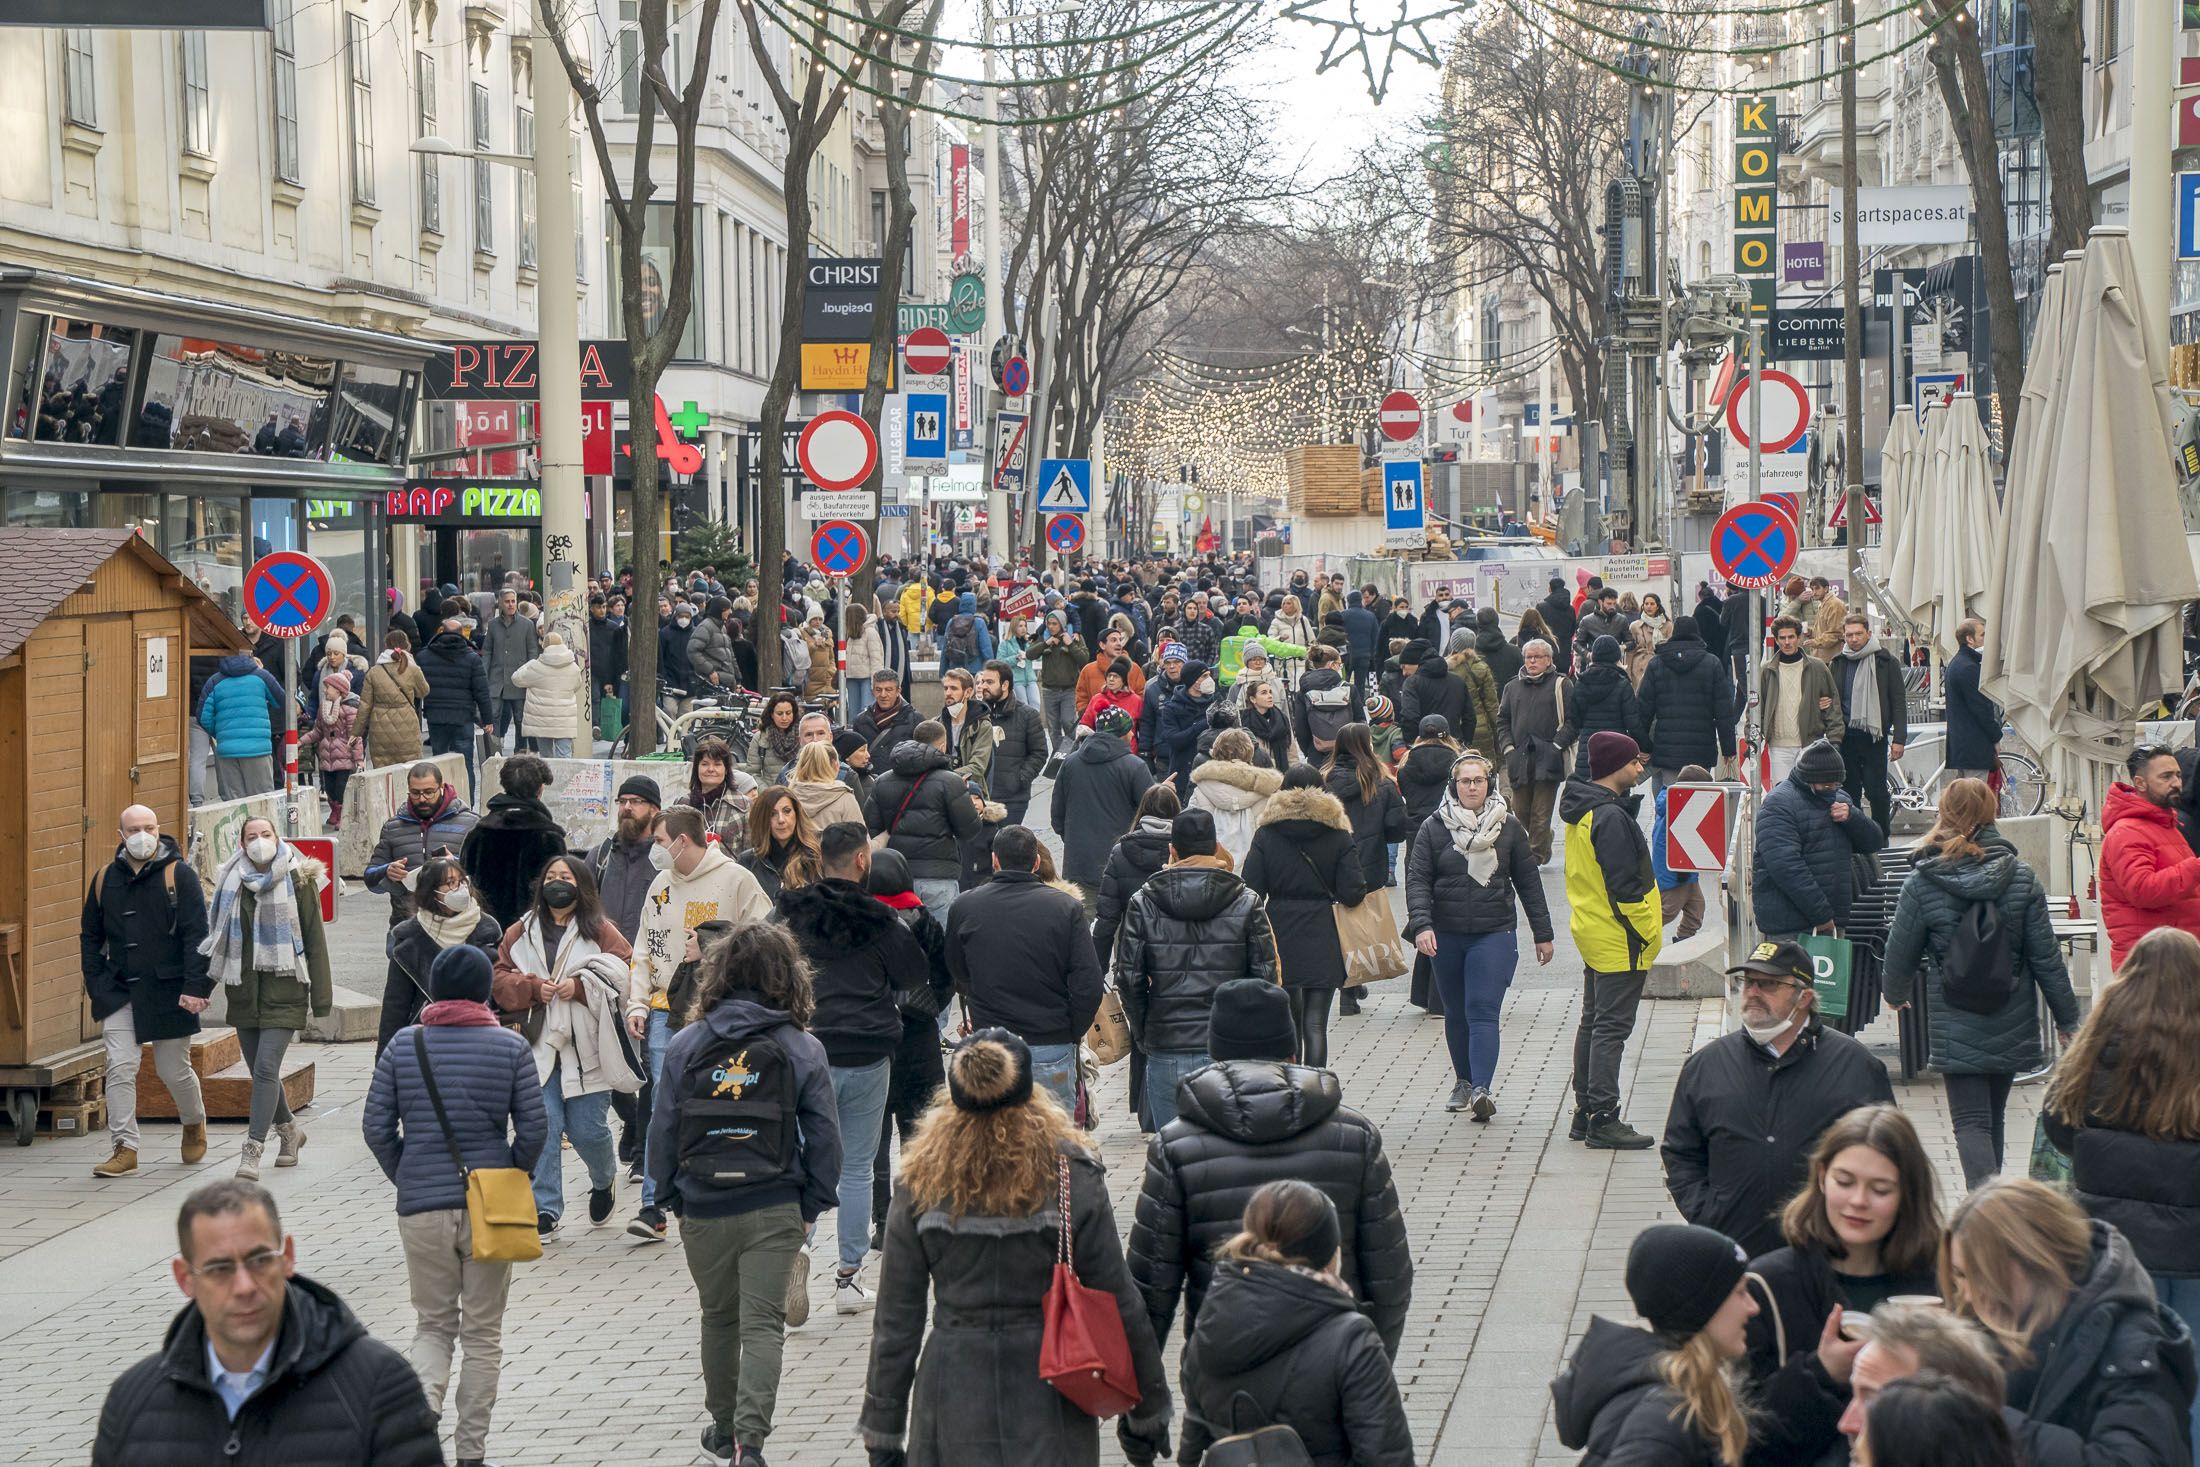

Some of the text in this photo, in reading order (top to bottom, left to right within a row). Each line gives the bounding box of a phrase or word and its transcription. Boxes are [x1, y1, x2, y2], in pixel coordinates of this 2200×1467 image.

[1833, 204, 1966, 226] sartspaces.at
[1786, 257, 1822, 269] HOTEL
[809, 265, 881, 285] CHRIST
[1876, 293, 1915, 308] PUA
[450, 345, 613, 388] PIZA
[812, 364, 849, 379] Haydn
[905, 380, 927, 390] ausgen.
[890, 407, 902, 474] PULL&BEAR
[748, 438, 795, 467] KN
[1011, 451, 1022, 466] 20
[904, 465, 925, 474] ausgen.
[1736, 460, 1765, 469] aus.
[1760, 469, 1803, 480] ufahrzeuge
[462, 487, 542, 516] PIZZA
[809, 494, 836, 502] ausgen.
[819, 510, 865, 518] Lieferverkehr
[823, 502, 870, 512] Baufahrzeuge
[1729, 572, 1777, 587] ANFANG
[263, 621, 312, 637] ANFANG
